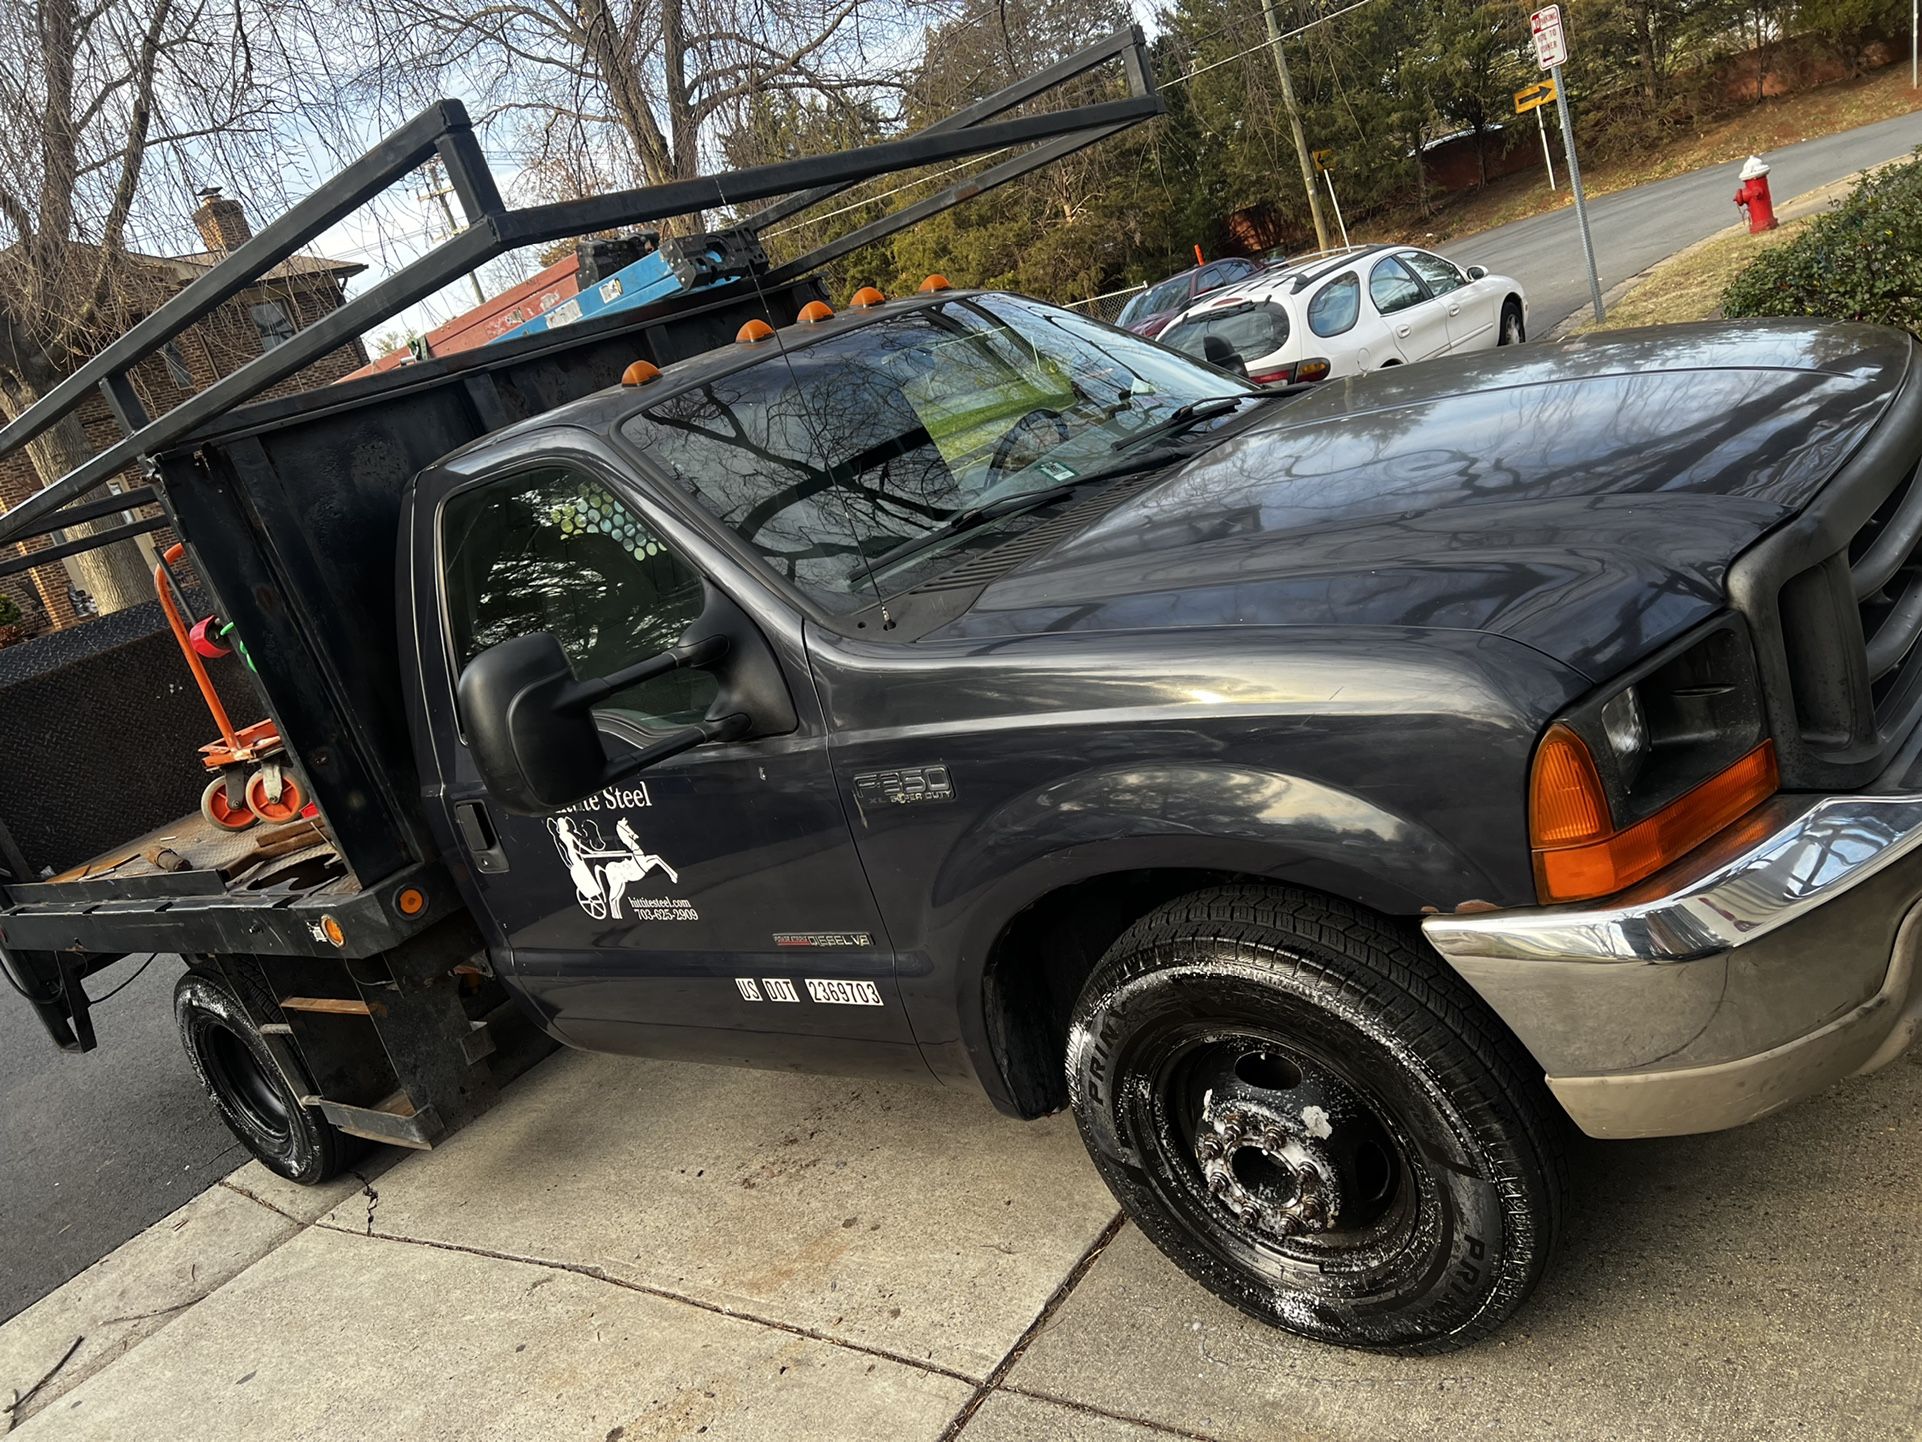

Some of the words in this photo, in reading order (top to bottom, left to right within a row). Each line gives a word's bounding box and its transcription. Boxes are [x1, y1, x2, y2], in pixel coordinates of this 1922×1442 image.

[602, 780, 653, 810] Steel
[924, 790, 951, 800] DUTY
[627, 896, 692, 908] hittitesteel.com
[633, 908, 699, 921] 703-625-2909
[807, 934, 853, 946] DIESEL
[736, 979, 760, 1000] US
[764, 980, 796, 1001] DOT
[808, 980, 882, 1004] 2369703
